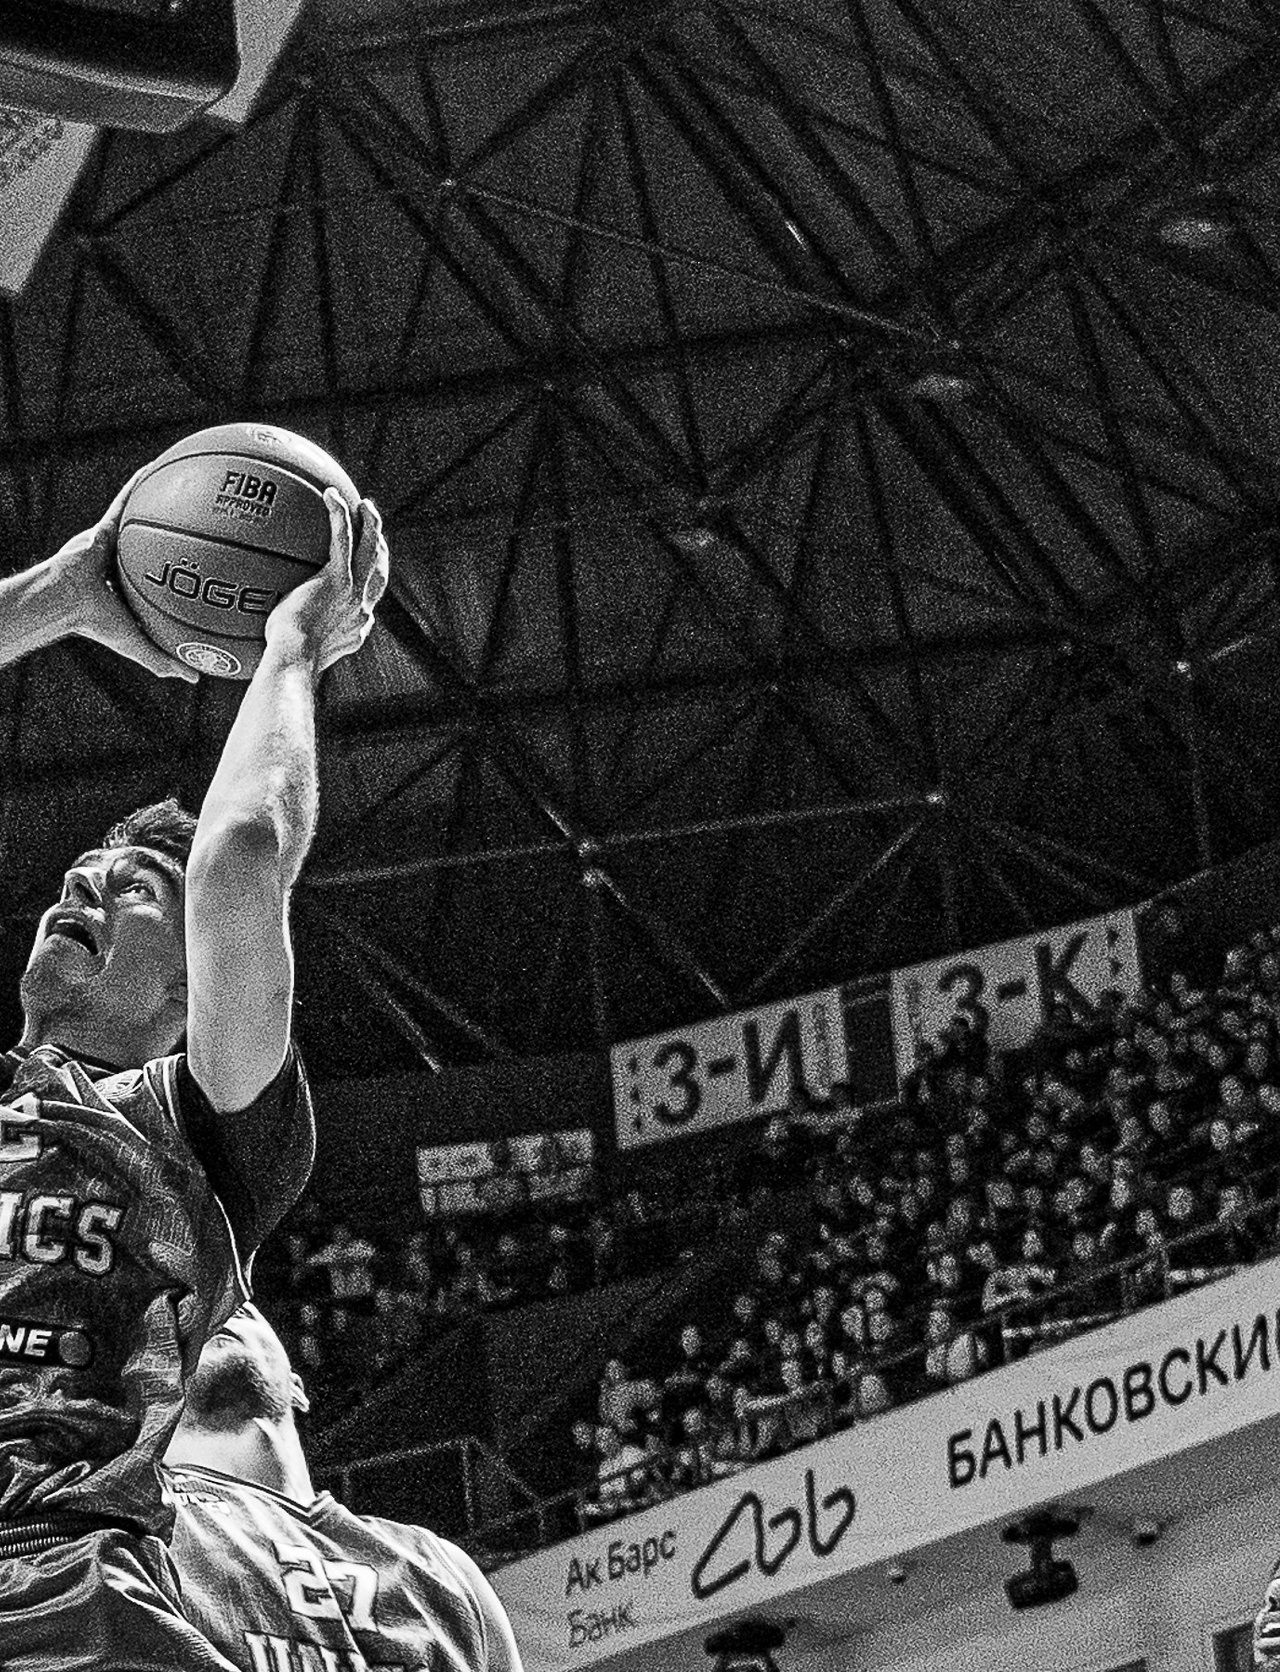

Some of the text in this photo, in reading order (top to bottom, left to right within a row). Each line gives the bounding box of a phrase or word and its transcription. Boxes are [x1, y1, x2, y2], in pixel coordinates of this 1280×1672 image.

[220, 470, 278, 507] FIBA
[145, 557, 277, 616] JÖGE
[947, 1308, 1280, 1489] БАНКОВСКИ
[272, 1541, 380, 1633] 27
[565, 1530, 677, 1597] Ак Барс
[568, 1599, 638, 1649] Банк
